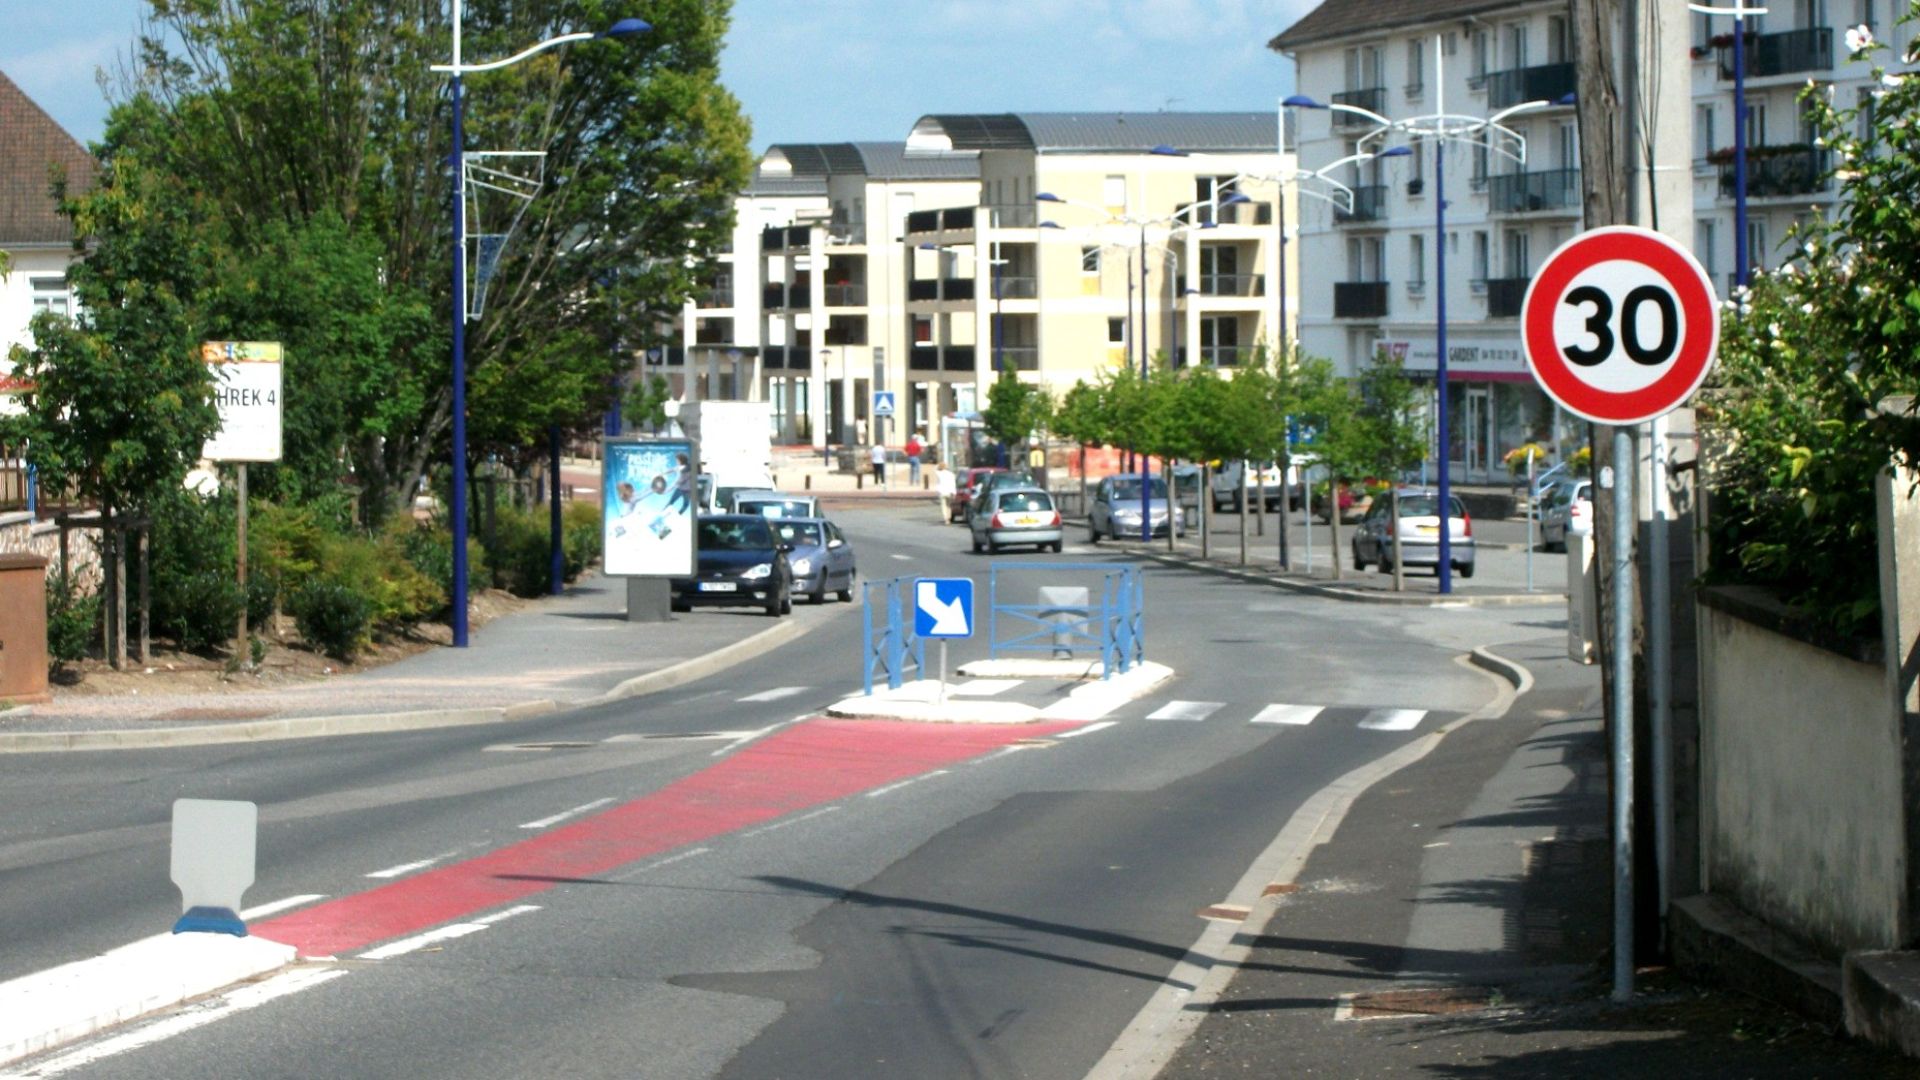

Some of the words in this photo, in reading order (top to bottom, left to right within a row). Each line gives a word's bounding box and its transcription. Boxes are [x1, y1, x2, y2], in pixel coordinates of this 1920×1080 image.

[1562, 284, 1678, 367] 30
[217, 388, 262, 406] HREK
[267, 390, 276, 406] 4
